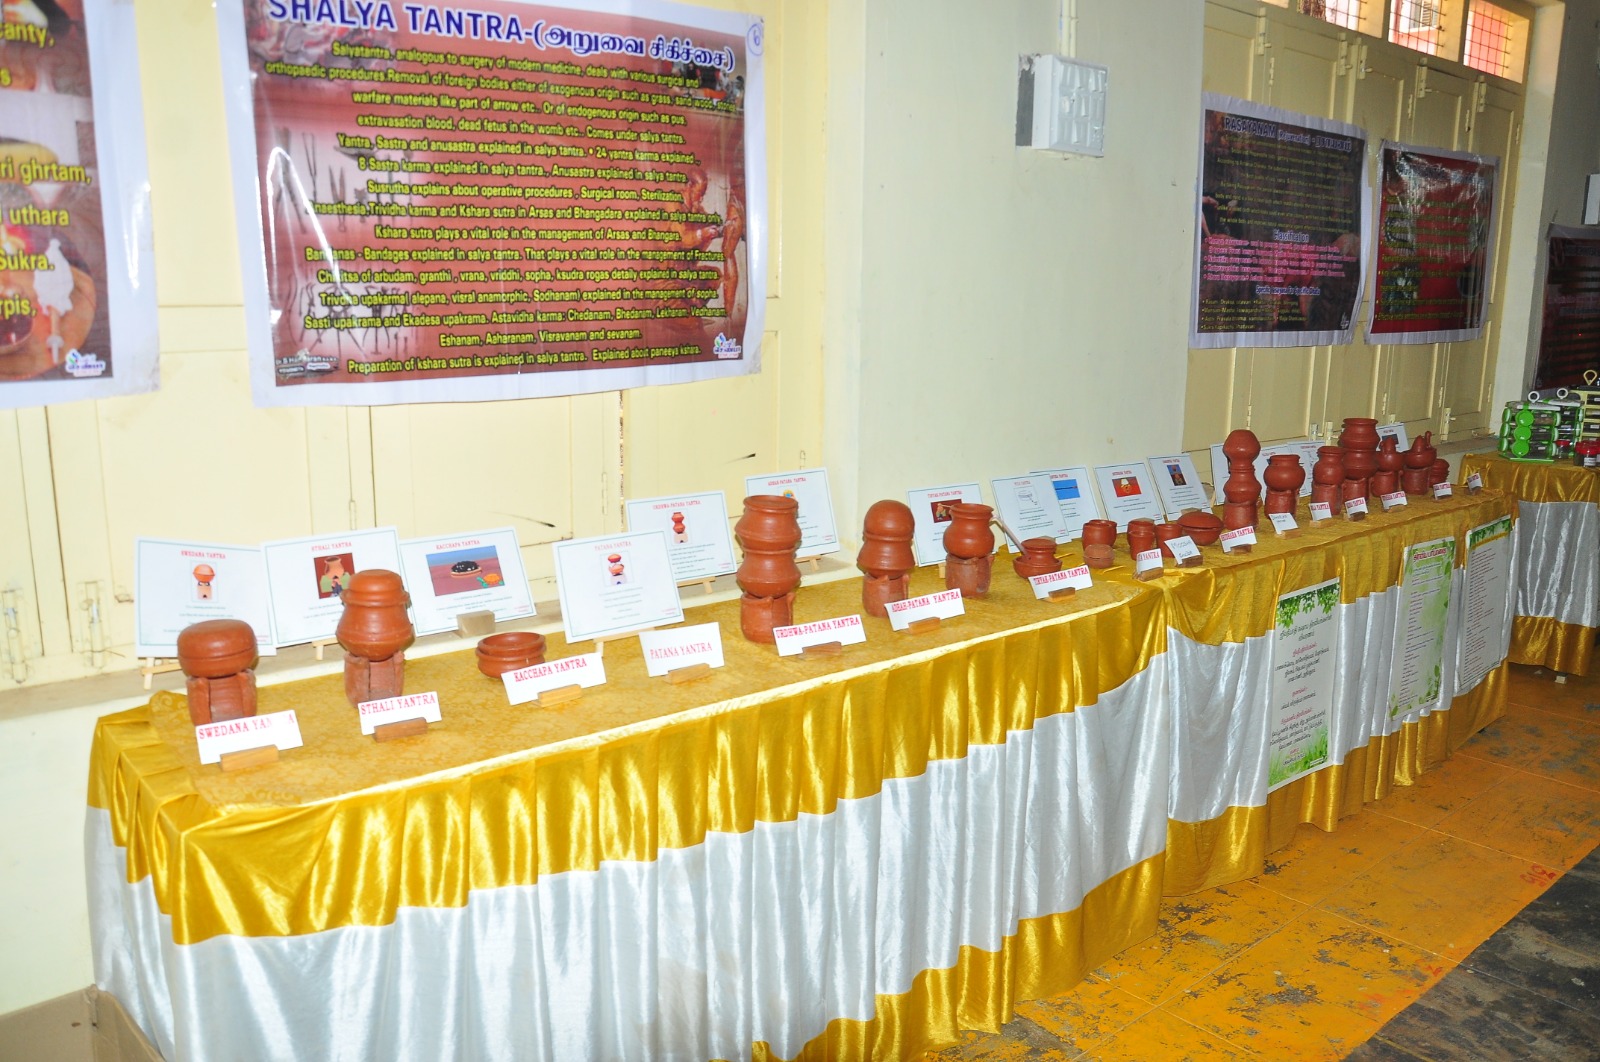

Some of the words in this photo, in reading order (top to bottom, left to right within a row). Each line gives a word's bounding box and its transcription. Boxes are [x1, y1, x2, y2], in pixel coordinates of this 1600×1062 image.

[269, 0, 395, 30] SHALYA
[396, 49, 444, 64] analogous
[459, 55, 493, 69] surgery
[507, 59, 541, 71] modern
[586, 65, 608, 77] deals
[610, 68, 628, 78] with
[630, 71, 655, 82] various
[656, 74, 684, 87] surgical
[686, 78, 699, 88] and
[265, 62, 326, 77] orthopaedic
[328, 67, 429, 84] procedures.Removal
[444, 73, 477, 90] foreign
[479, 76, 509, 90] bodies
[510, 80, 536, 92] either
[550, 84, 594, 98] exogenous
[596, 88, 619, 101] origin
[621, 90, 638, 100] such
[352, 90, 391, 104] warfare
[394, 94, 438, 106] materials
[439, 94, 457, 107] like
[459, 97, 478, 109] part
[492, 100, 518, 111] arrow
[567, 105, 616, 119] endogenous
[618, 109, 639, 122] origin
[357, 115, 424, 128] extravasation
[483, 119, 507, 132] fetus
[586, 125, 614, 139] Comes
[615, 129, 638, 140] under
[639, 131, 660, 143] salya
[1225, 117, 1277, 139] RASAYANAM
[376, 135, 408, 149] Sastra
[430, 140, 476, 152] anusastra
[478, 141, 521, 154] explained
[534, 144, 557, 156] salya
[609, 150, 633, 160] yantra
[635, 150, 659, 161] karma
[661, 153, 694, 163] explained
[20, 159, 92, 185] ghrtam,
[368, 156, 400, 171] Sastra
[401, 160, 431, 172] karma
[433, 161, 477, 174] explained
[491, 163, 515, 175] salya
[551, 164, 595, 177] Anusastra
[596, 167, 634, 179] explained
[644, 170, 664, 181] salya
[367, 179, 410, 194] Susrutha
[412, 183, 450, 195] explains
[452, 183, 479, 196] about
[481, 185, 523, 197] operative
[524, 186, 573, 198] procedures
[581, 185, 614, 201] Surgical
[10, 204, 70, 227] uthara
[408, 205, 438, 216] karma
[459, 204, 490, 217] Kshara
[492, 207, 516, 217] sutra
[529, 205, 554, 218] Arsas
[624, 209, 660, 220] explained
[670, 211, 686, 221] salya
[375, 225, 408, 238] Kshara
[410, 228, 433, 239] sutra
[435, 227, 460, 240] plays
[470, 228, 490, 239] vital
[538, 229, 593, 242] management
[606, 228, 630, 240] Arsas
[364, 246, 410, 263] Bandages
[412, 248, 454, 261] explained
[468, 248, 491, 260] salya
[547, 249, 570, 261] plays
[579, 249, 597, 259] vital
[642, 250, 685, 262] management
[418, 270, 451, 284] granthi
[556, 269, 584, 280] ksudra
[586, 270, 609, 282] rogas
[639, 269, 669, 280] explained
[678, 269, 698, 279] salya
[451, 292, 476, 303] visral
[582, 289, 622, 301] explained
[645, 289, 686, 301] management
[304, 315, 331, 328] Sasti
[333, 317, 382, 328] upakrama
[403, 313, 441, 326] Ekadesa
[492, 311, 534, 323] Astavidha
[539, 331, 587, 342] Visravanam
[589, 328, 606, 340] and
[347, 359, 404, 373] Preparation
[418, 358, 447, 369] kshara
[449, 357, 472, 368] sutra
[484, 353, 525, 367] explained
[537, 353, 559, 363] salya
[592, 348, 630, 361] Explained
[631, 348, 648, 358] about
[650, 347, 679, 358] paneeya
[933, 590, 960, 604] YANTRA
[832, 616, 860, 629] YANTRA
[650, 646, 680, 660] PATANA
[680, 641, 712, 656] YANTRA
[514, 665, 553, 683] KACCHAPA
[554, 657, 587, 673] YANTRA
[361, 700, 395, 715] STHALI
[396, 693, 436, 709] YANTRA
[199, 721, 249, 740] SWEDANA
[252, 713, 295, 731] YANA
